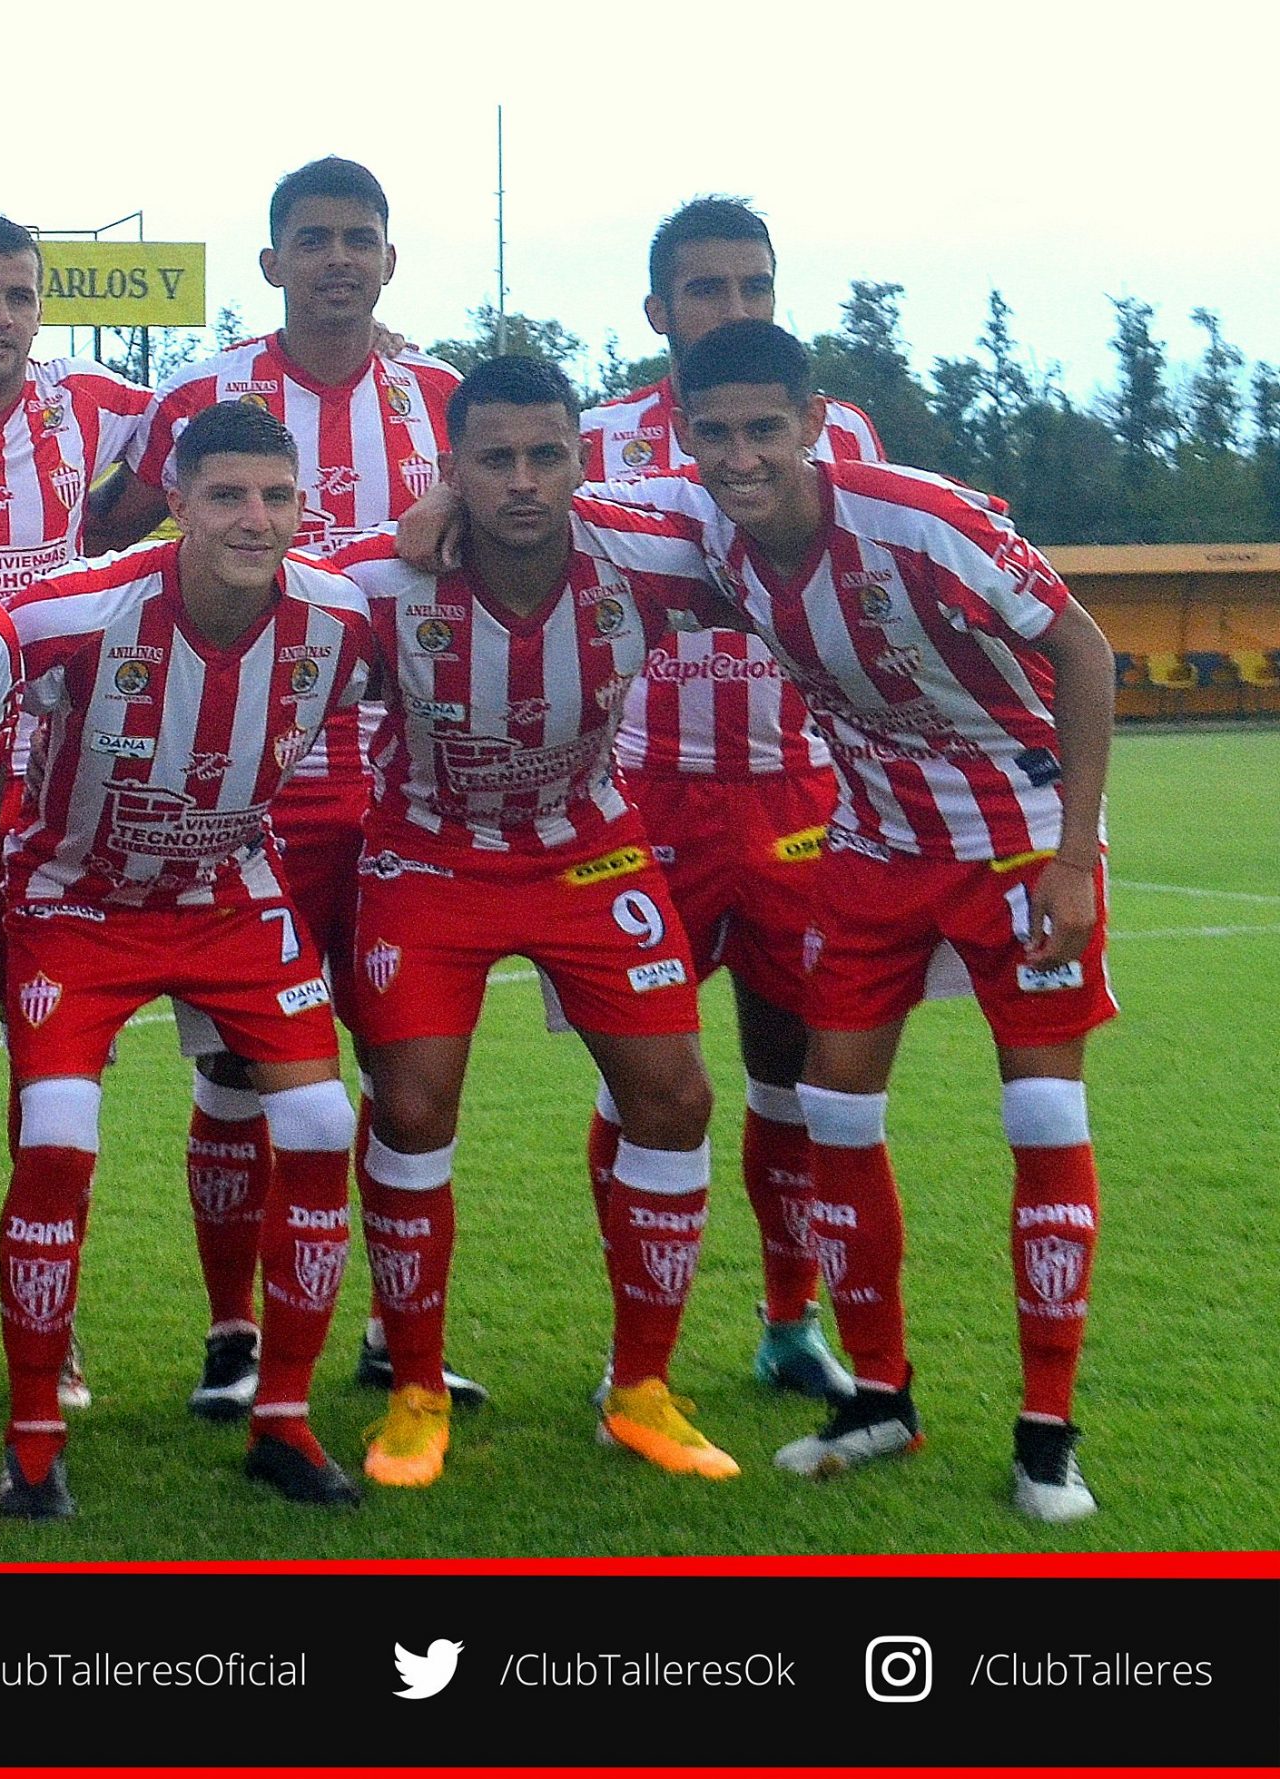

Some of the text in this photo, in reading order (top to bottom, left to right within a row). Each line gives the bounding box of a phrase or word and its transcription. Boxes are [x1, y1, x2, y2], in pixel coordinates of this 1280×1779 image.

[47, 266, 149, 301] ARLOS
[159, 268, 185, 300] V
[225, 380, 277, 392] ANILINAS
[107, 646, 163, 662] ANILINAS
[644, 649, 788, 686] RapiCuot
[98, 737, 146, 751] DANA
[611, 889, 666, 950] 9
[260, 907, 302, 964] 7
[285, 980, 323, 1004] DANA
[287, 1204, 350, 1229] DAN
